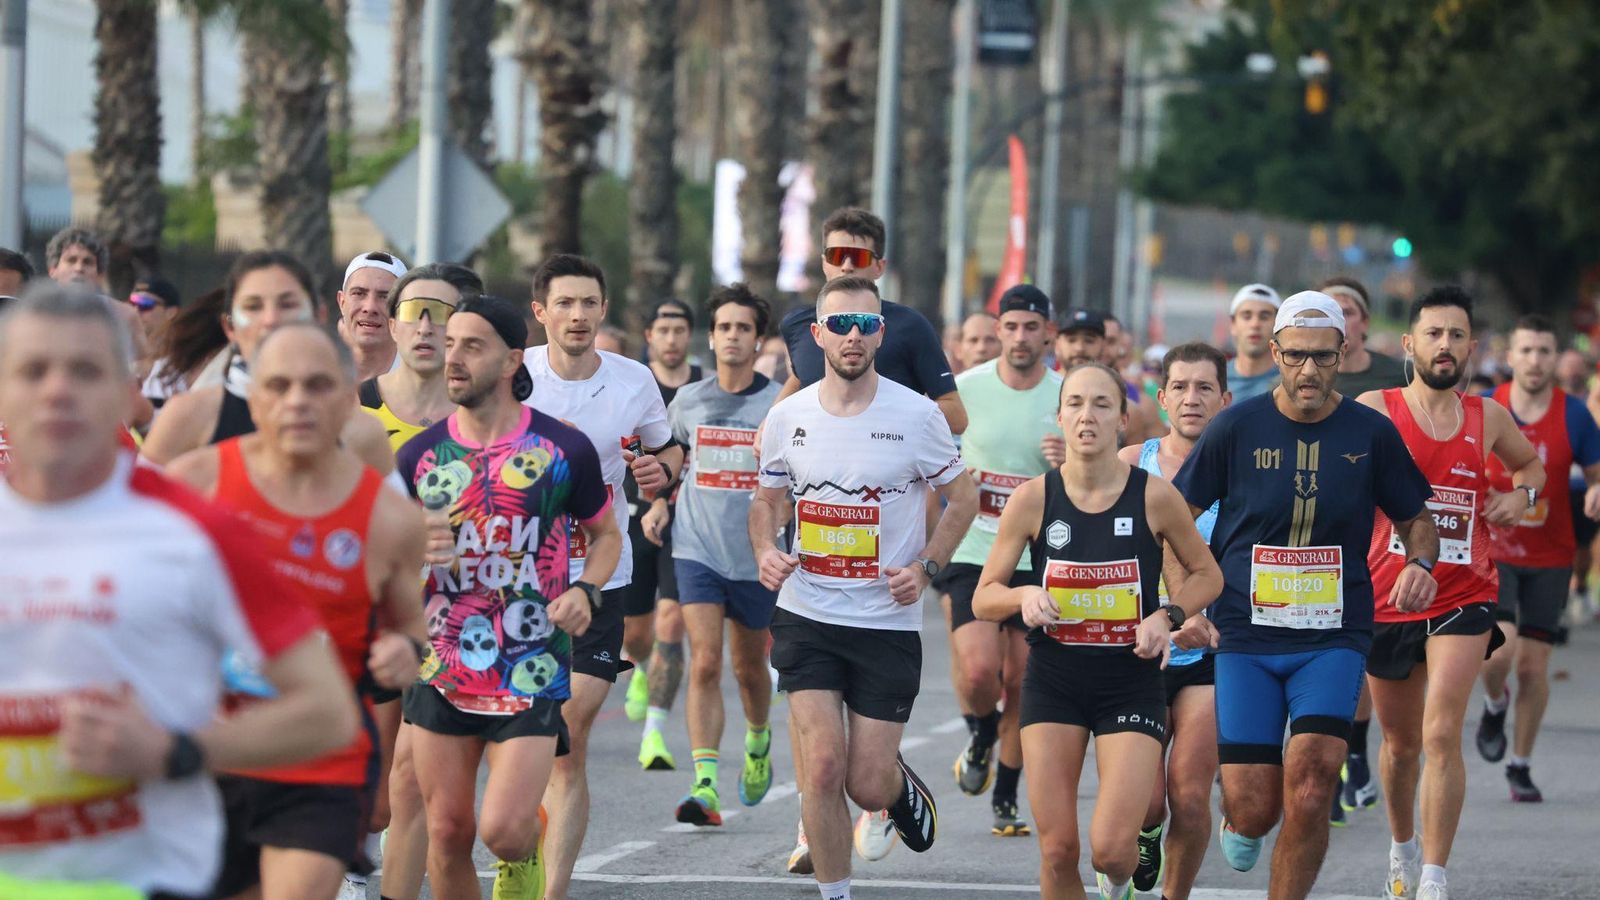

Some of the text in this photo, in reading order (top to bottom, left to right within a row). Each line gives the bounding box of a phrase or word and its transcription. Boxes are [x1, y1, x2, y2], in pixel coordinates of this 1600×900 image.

[792, 439, 805, 447] FFL
[871, 432, 904, 441] KIPRUN
[711, 449, 744, 463] 7913
[1253, 447, 1280, 469] 101
[817, 505, 873, 520] GENERALI
[818, 529, 856, 545] 1866
[1277, 551, 1335, 564] GENERALI
[1069, 565, 1133, 579] GENERALI
[1272, 577, 1324, 593] 10820
[1070, 593, 1116, 608] 4519
